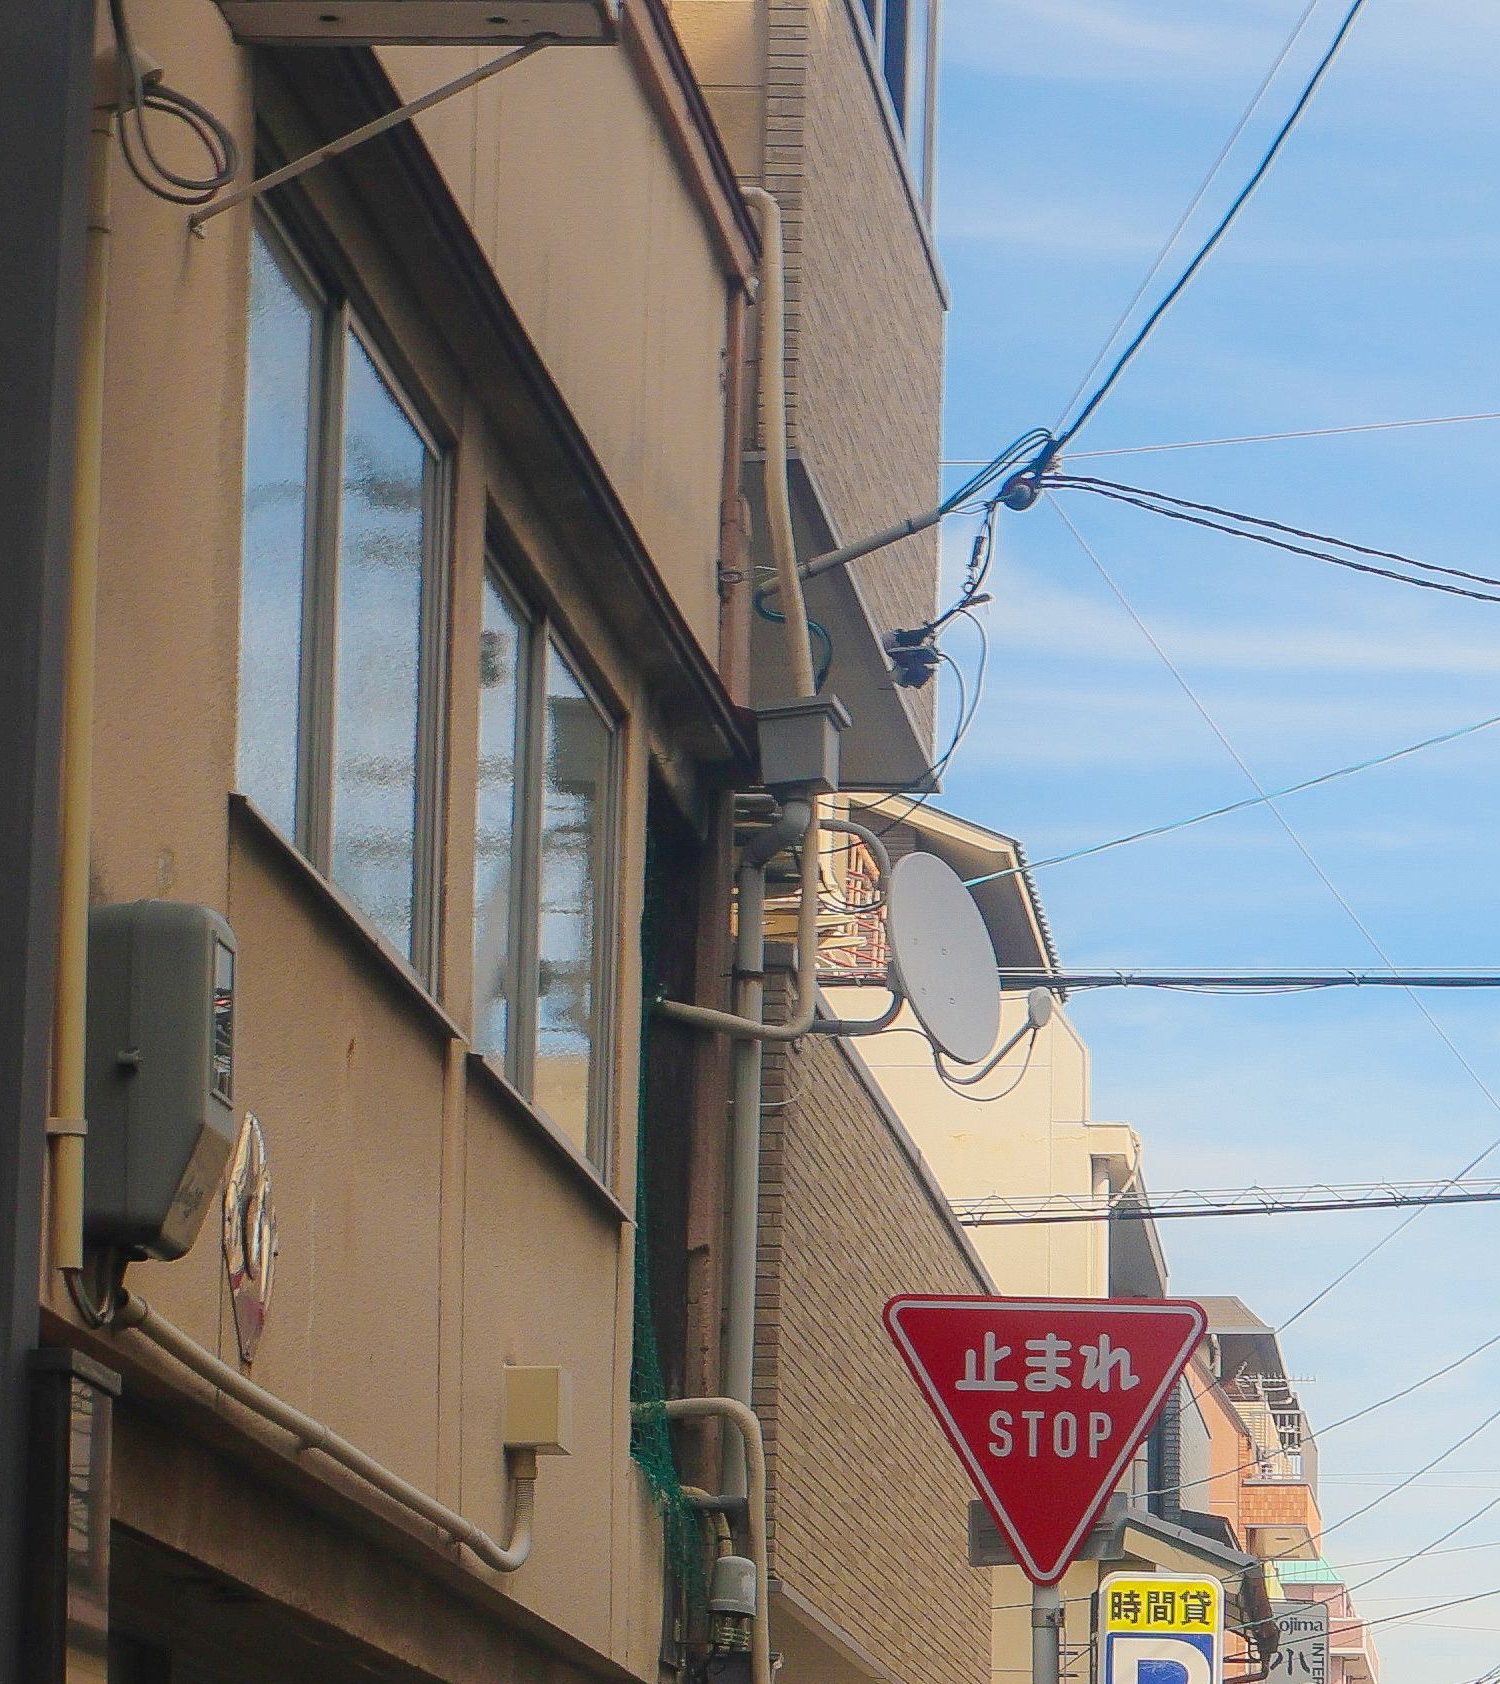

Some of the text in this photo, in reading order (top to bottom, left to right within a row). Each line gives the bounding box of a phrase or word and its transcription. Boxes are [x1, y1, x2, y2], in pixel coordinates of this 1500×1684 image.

[955, 1331, 1141, 1393] 止まれ
[988, 1410, 1113, 1458] STOP
[1111, 1590, 1212, 1626] 時間貸
[1278, 1616, 1324, 1636] ojima
